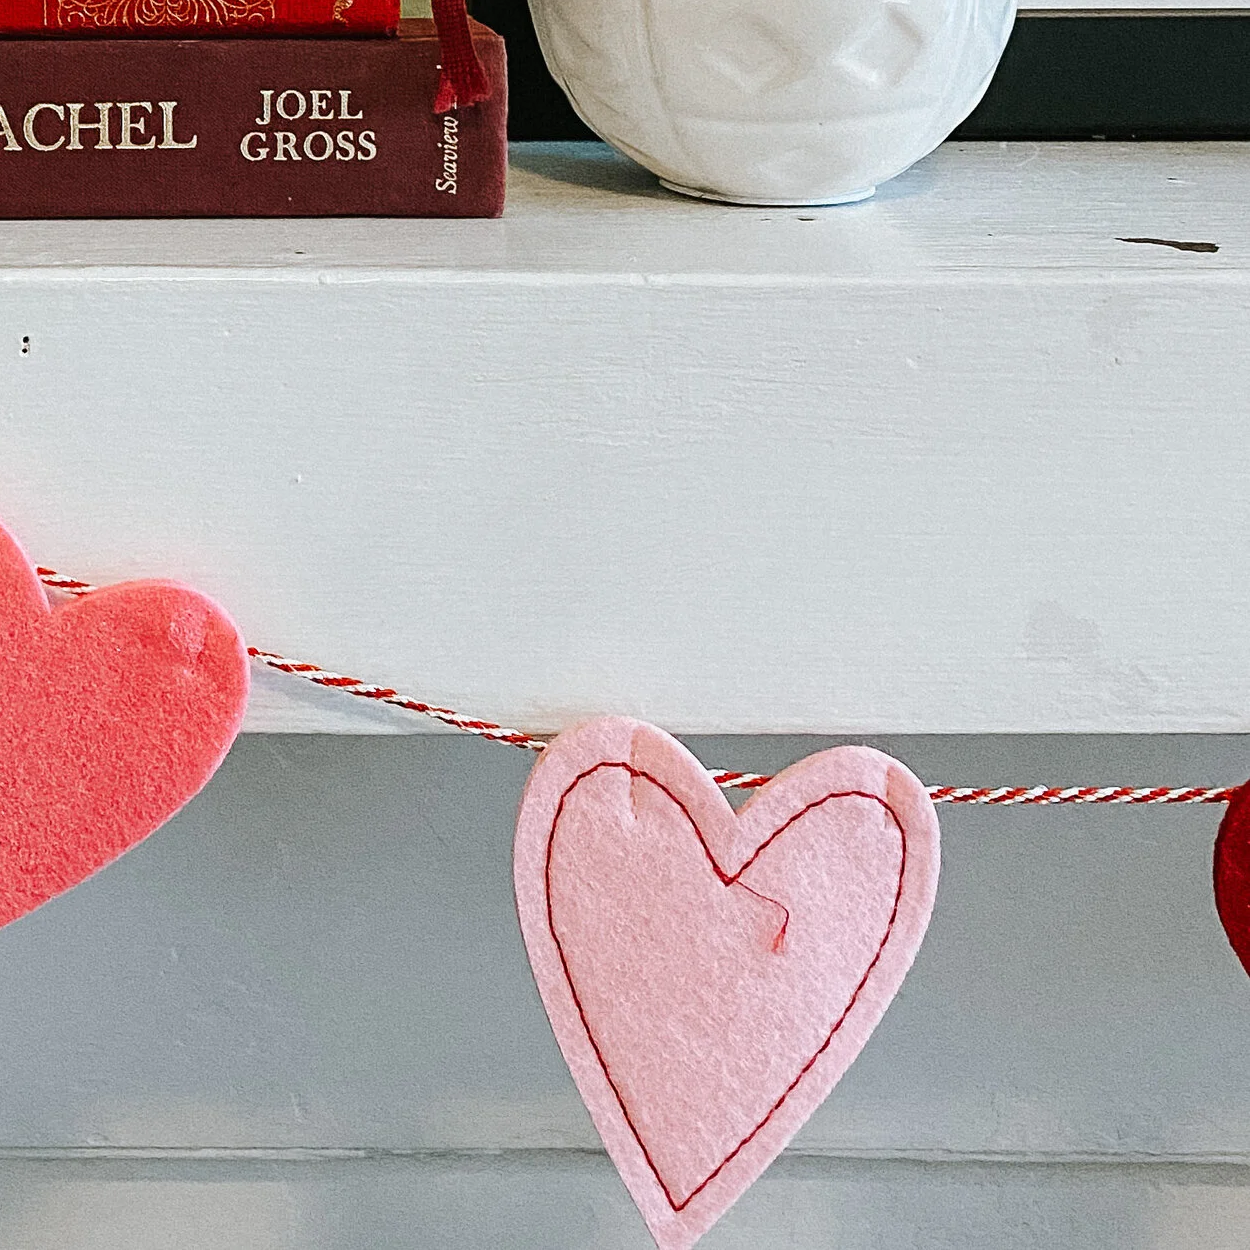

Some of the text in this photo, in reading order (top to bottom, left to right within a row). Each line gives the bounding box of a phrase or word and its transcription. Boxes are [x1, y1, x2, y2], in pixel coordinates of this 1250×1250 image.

[255, 90, 363, 125] JOEL
[240, 131, 377, 161] GROSS
[435, 116, 459, 195] Seaview
